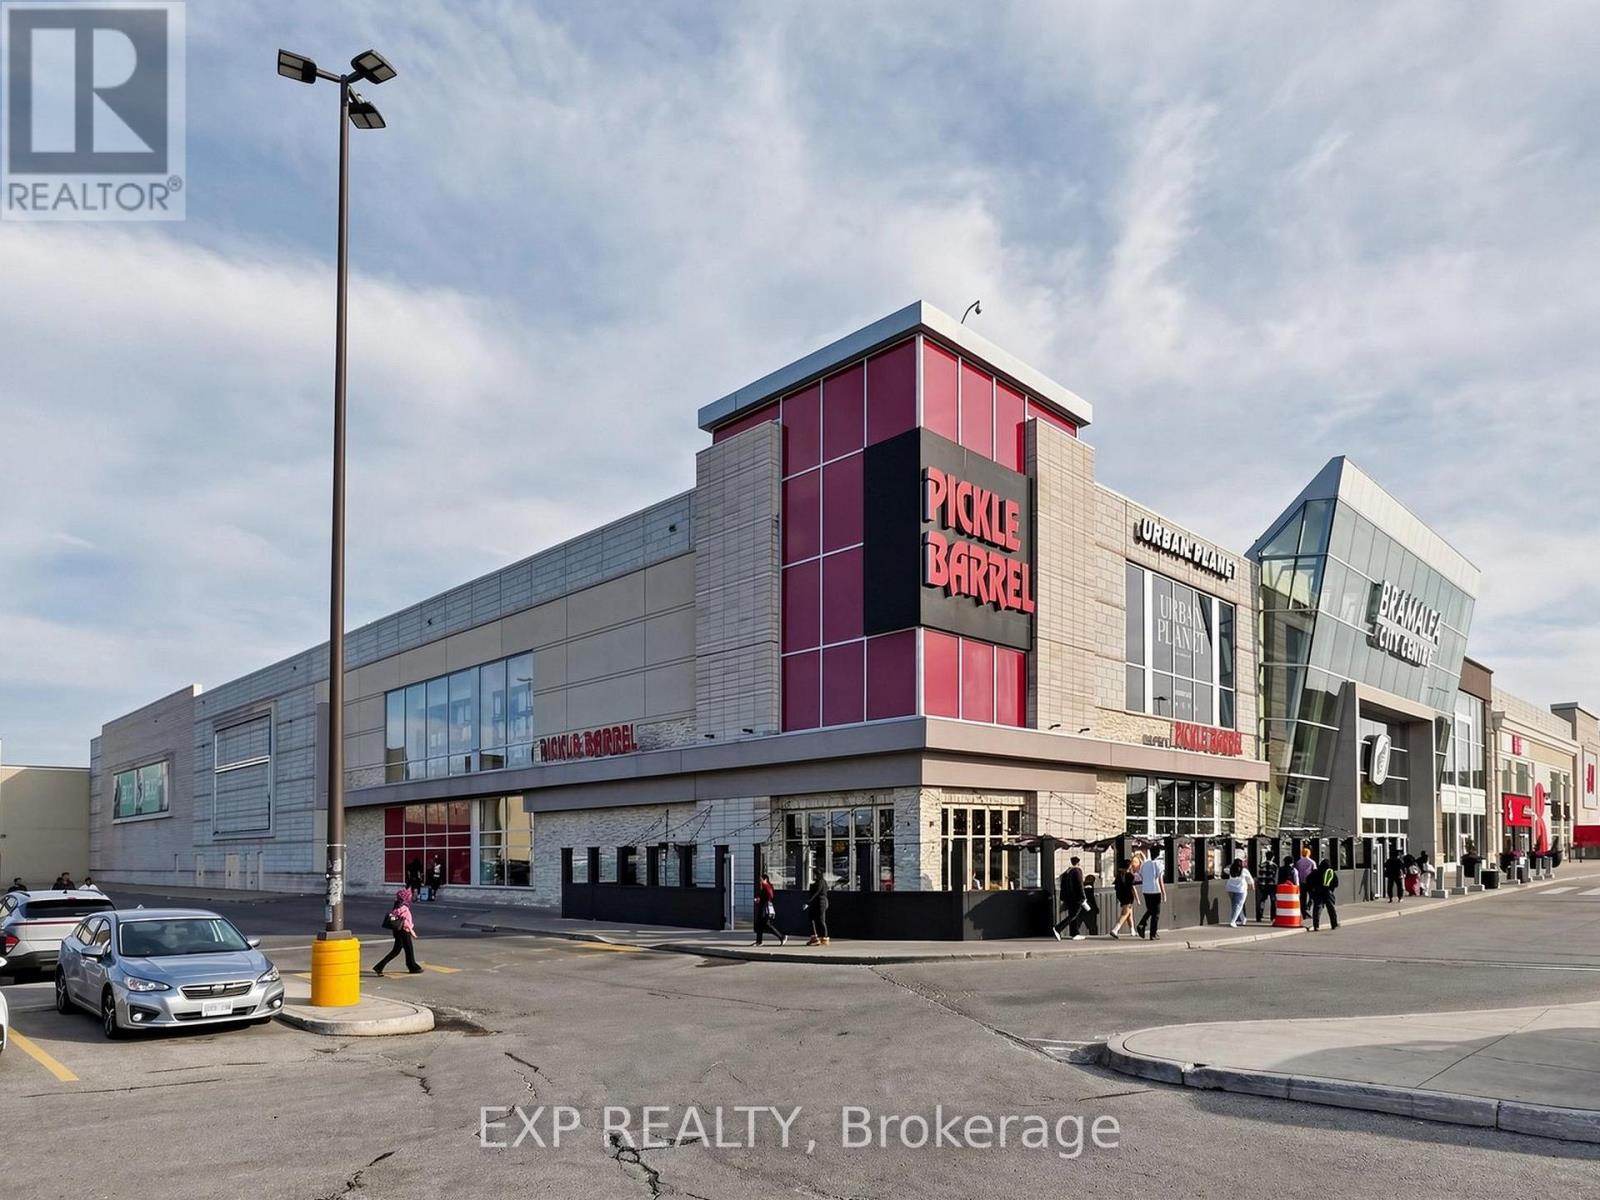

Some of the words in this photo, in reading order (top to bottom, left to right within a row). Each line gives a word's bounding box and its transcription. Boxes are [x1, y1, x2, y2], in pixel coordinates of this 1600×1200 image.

[922, 465, 1021, 552] PICKLE
[922, 529, 1035, 614] BARREL
[1141, 518, 1192, 560] URBAN
[1193, 543, 1237, 579] PLANET
[1160, 594, 1204, 629] URBAN
[1379, 580, 1441, 647] BRAMALEA
[1379, 626, 1401, 653] CITY
[1401, 637, 1432, 668] CENTRE
[584, 723, 638, 758] BARREL
